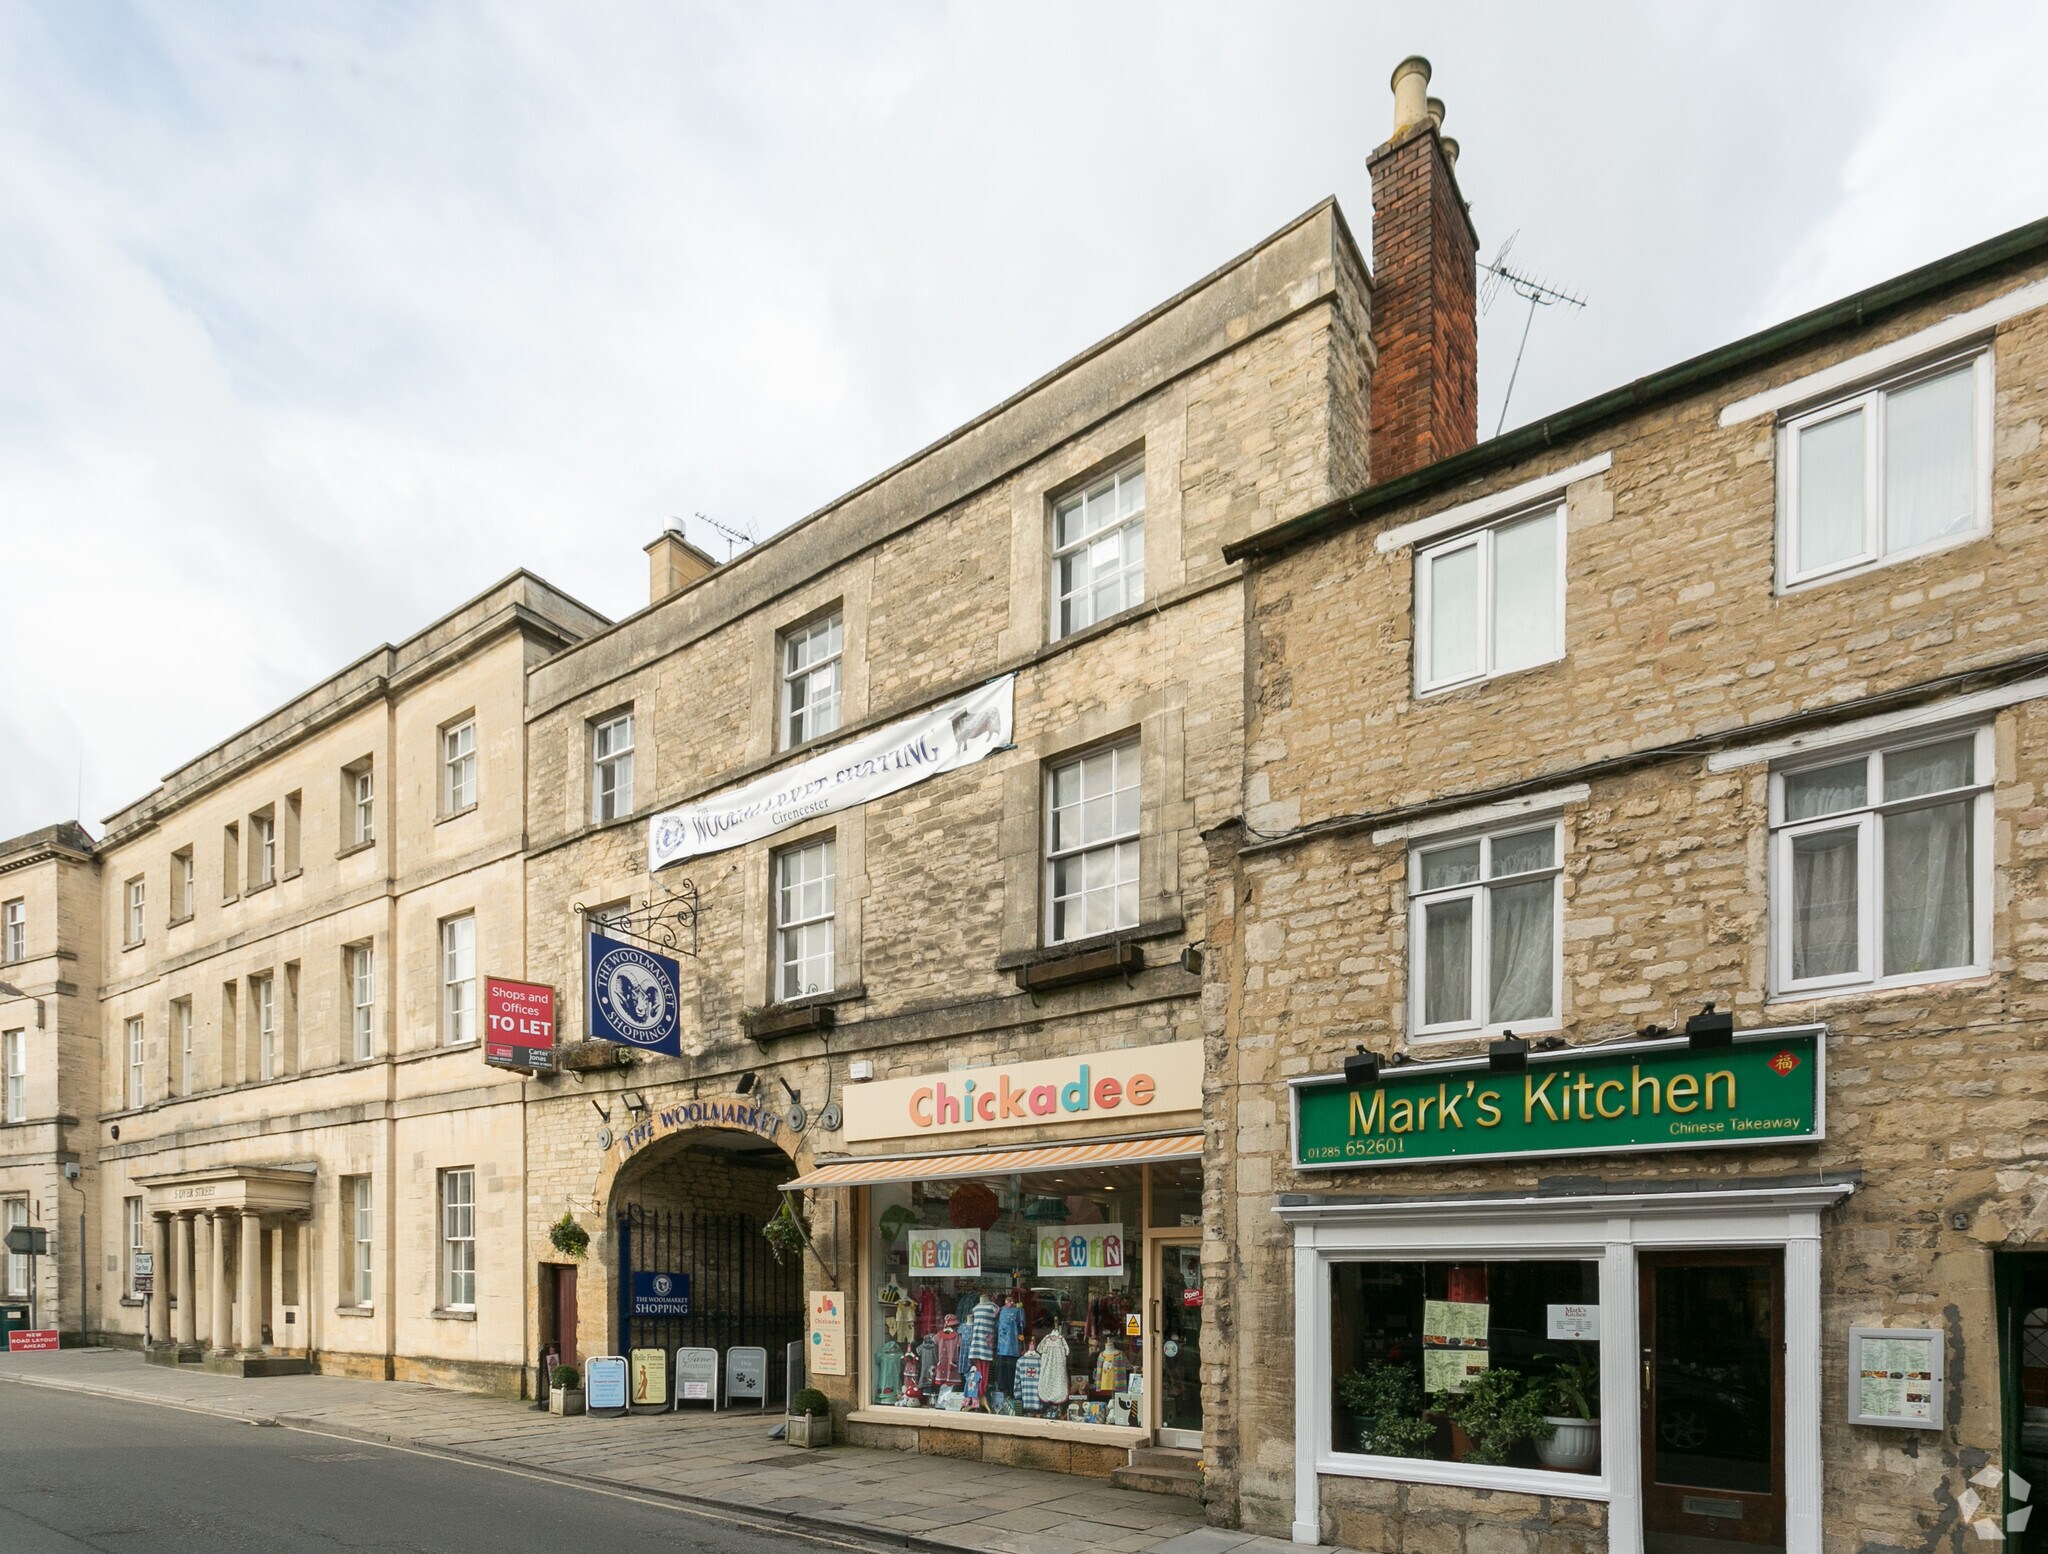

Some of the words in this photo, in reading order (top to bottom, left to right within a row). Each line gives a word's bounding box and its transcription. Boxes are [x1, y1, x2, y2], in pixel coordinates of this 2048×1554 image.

[772, 798, 830, 826] Cirencester
[598, 961, 613, 987] THE
[612, 951, 675, 1008] WOOLMARKET
[492, 986, 526, 1001] Shops
[528, 994, 549, 1004] and
[501, 1002, 540, 1016] Offices
[489, 1014, 515, 1032] TO
[519, 1018, 552, 1036] LET
[607, 1011, 666, 1041] SHOPPING
[528, 1048, 548, 1057] Carter
[528, 1054, 547, 1062] Jonas
[1775, 1054, 1793, 1070] 福
[909, 1063, 1156, 1128] Chickadee
[1349, 1080, 1502, 1137] Mark's
[1524, 1064, 1737, 1123] Kitchen
[623, 1118, 655, 1151] THE
[660, 1101, 783, 1137] WOOLMARKET
[1669, 1120, 1725, 1136] Chinese
[1730, 1116, 1801, 1134] Takeaway
[1307, 1145, 1341, 1159] 01285
[1345, 1137, 1405, 1156] 652601
[194, 1185, 216, 1198] STREET
[913, 1247, 951, 1267] NEW
[1042, 1246, 1087, 1267] NEW
[1184, 1290, 1200, 1300] Open
[635, 1303, 688, 1314] SHOPPING
[634, 1353, 646, 1361] Belle
[647, 1353, 664, 1361] Femme
